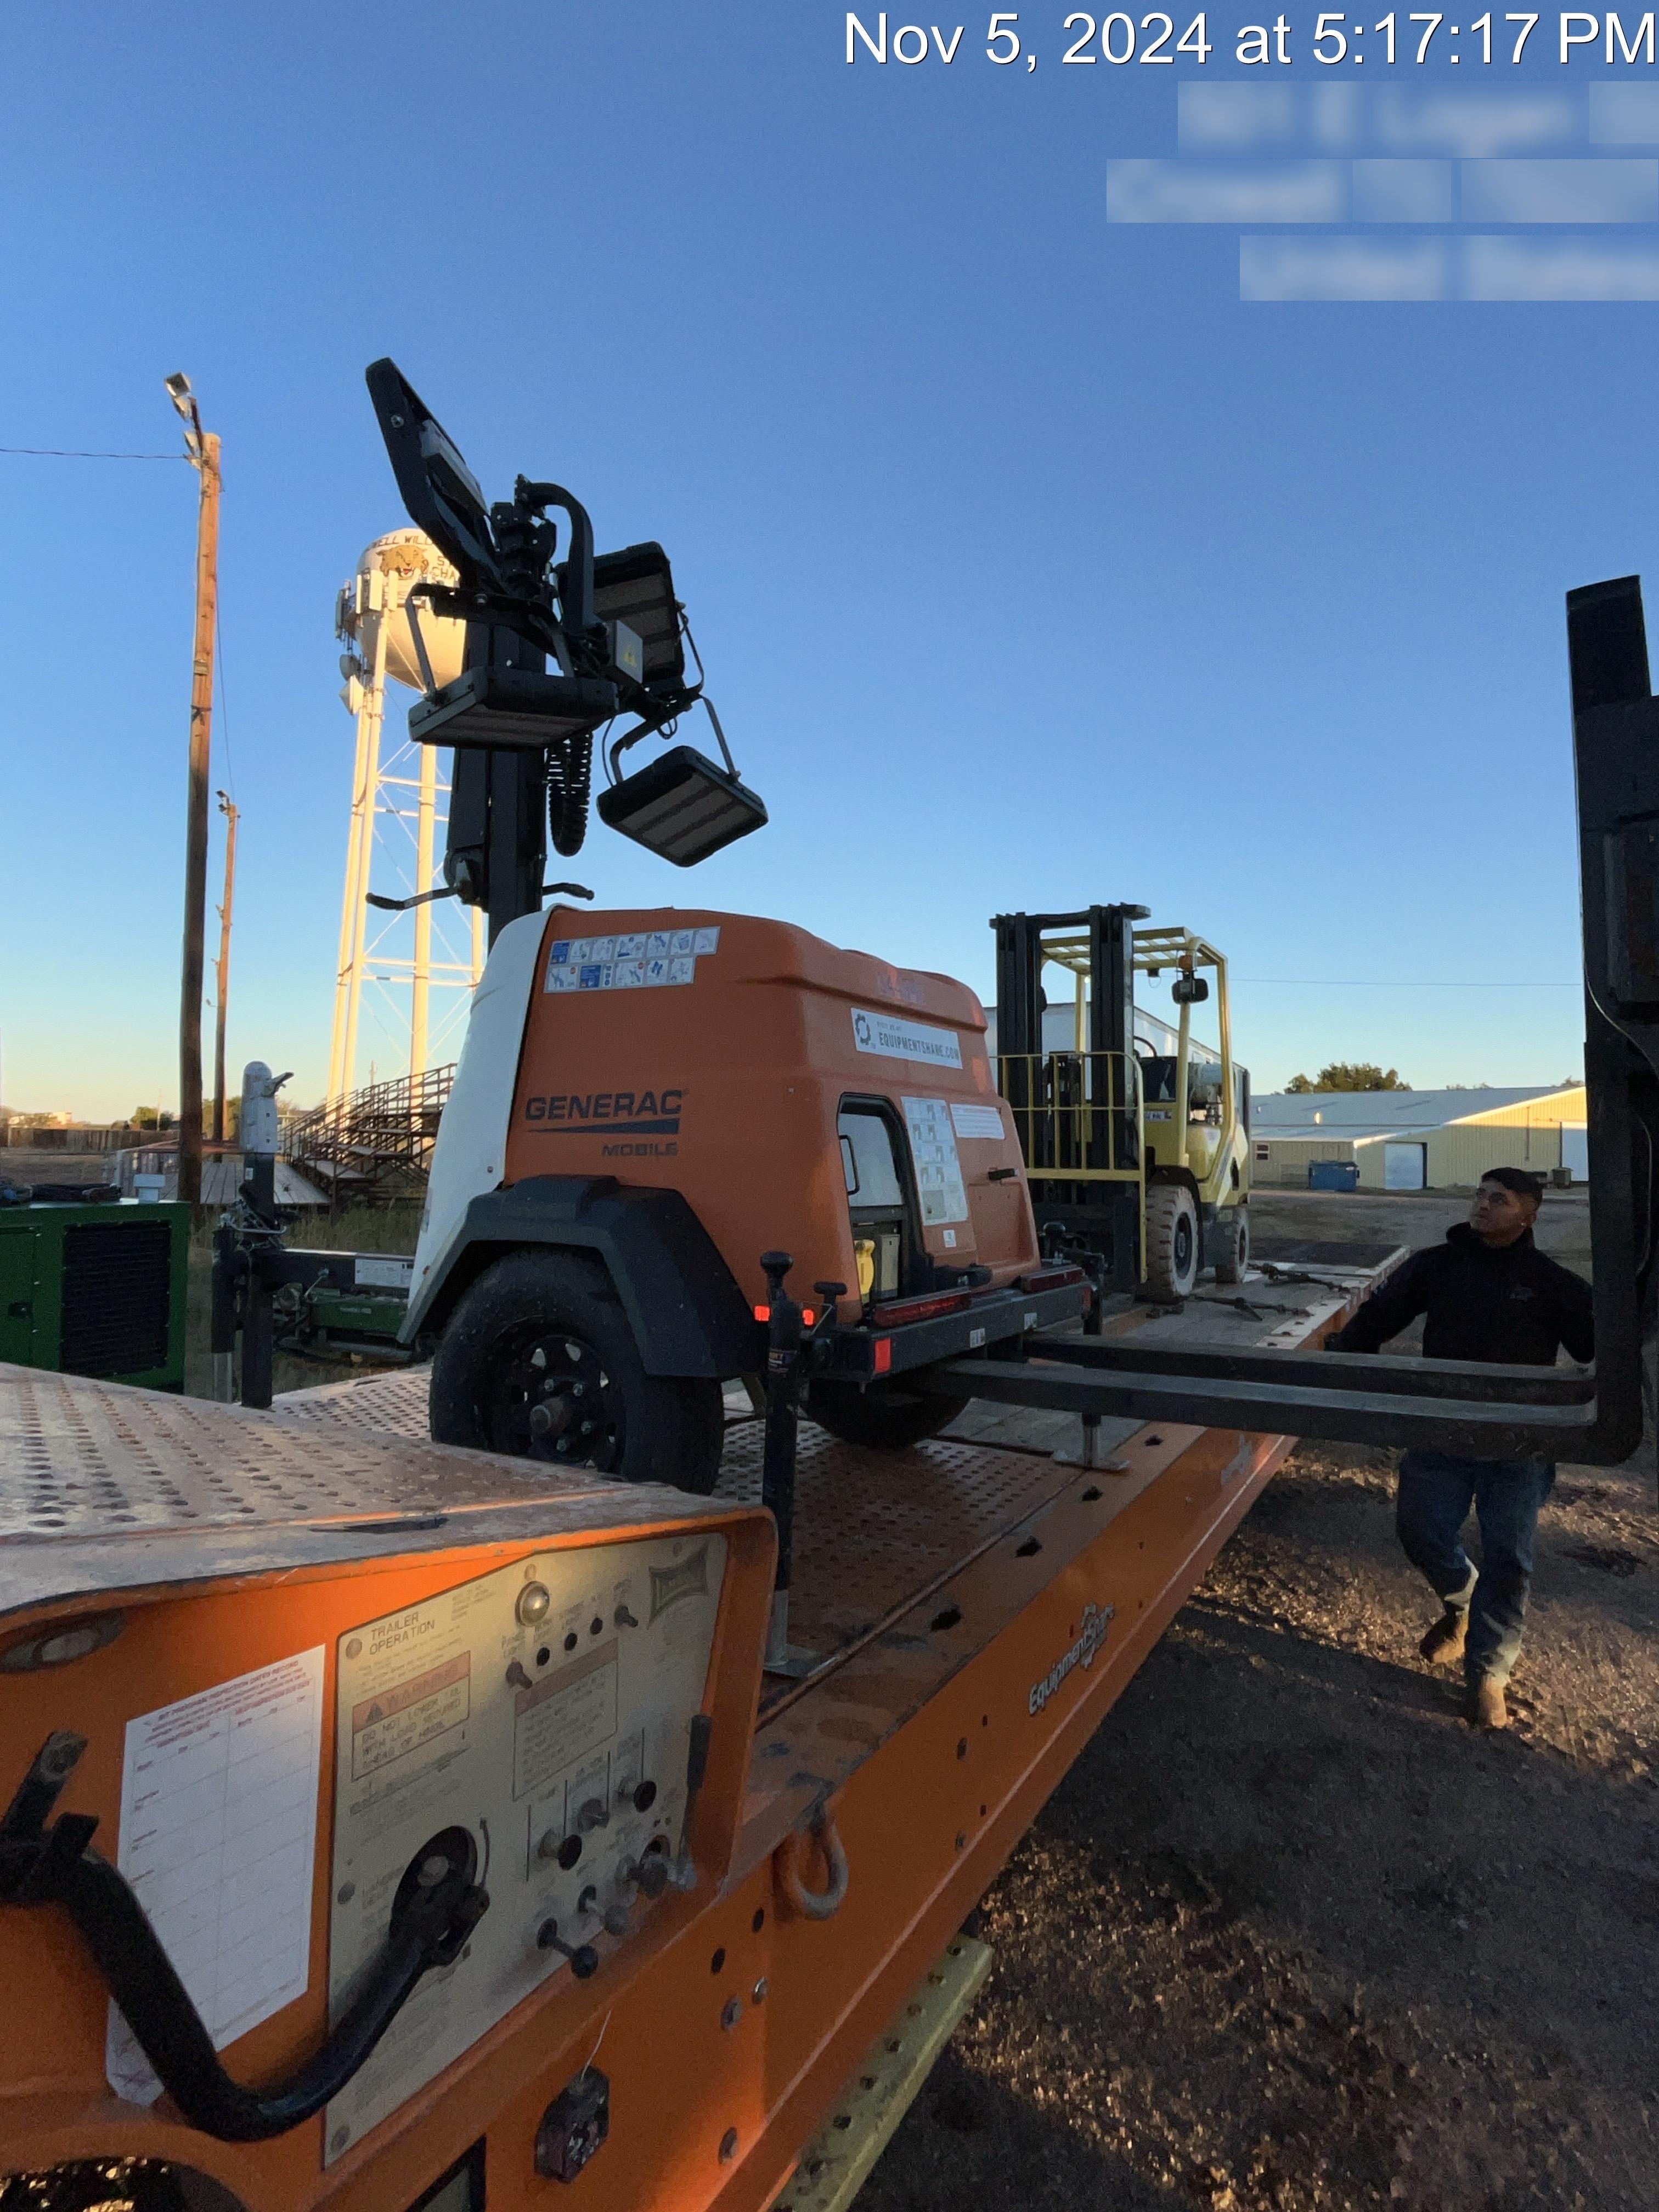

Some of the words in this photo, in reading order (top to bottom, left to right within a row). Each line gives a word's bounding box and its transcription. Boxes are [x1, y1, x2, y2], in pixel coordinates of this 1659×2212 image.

[525, 1089, 682, 1121] GENERAC
[602, 1142, 679, 1157] MOBILE
[369, 1619, 436, 1655] OPERATION
[371, 1611, 419, 1641] TRAILER
